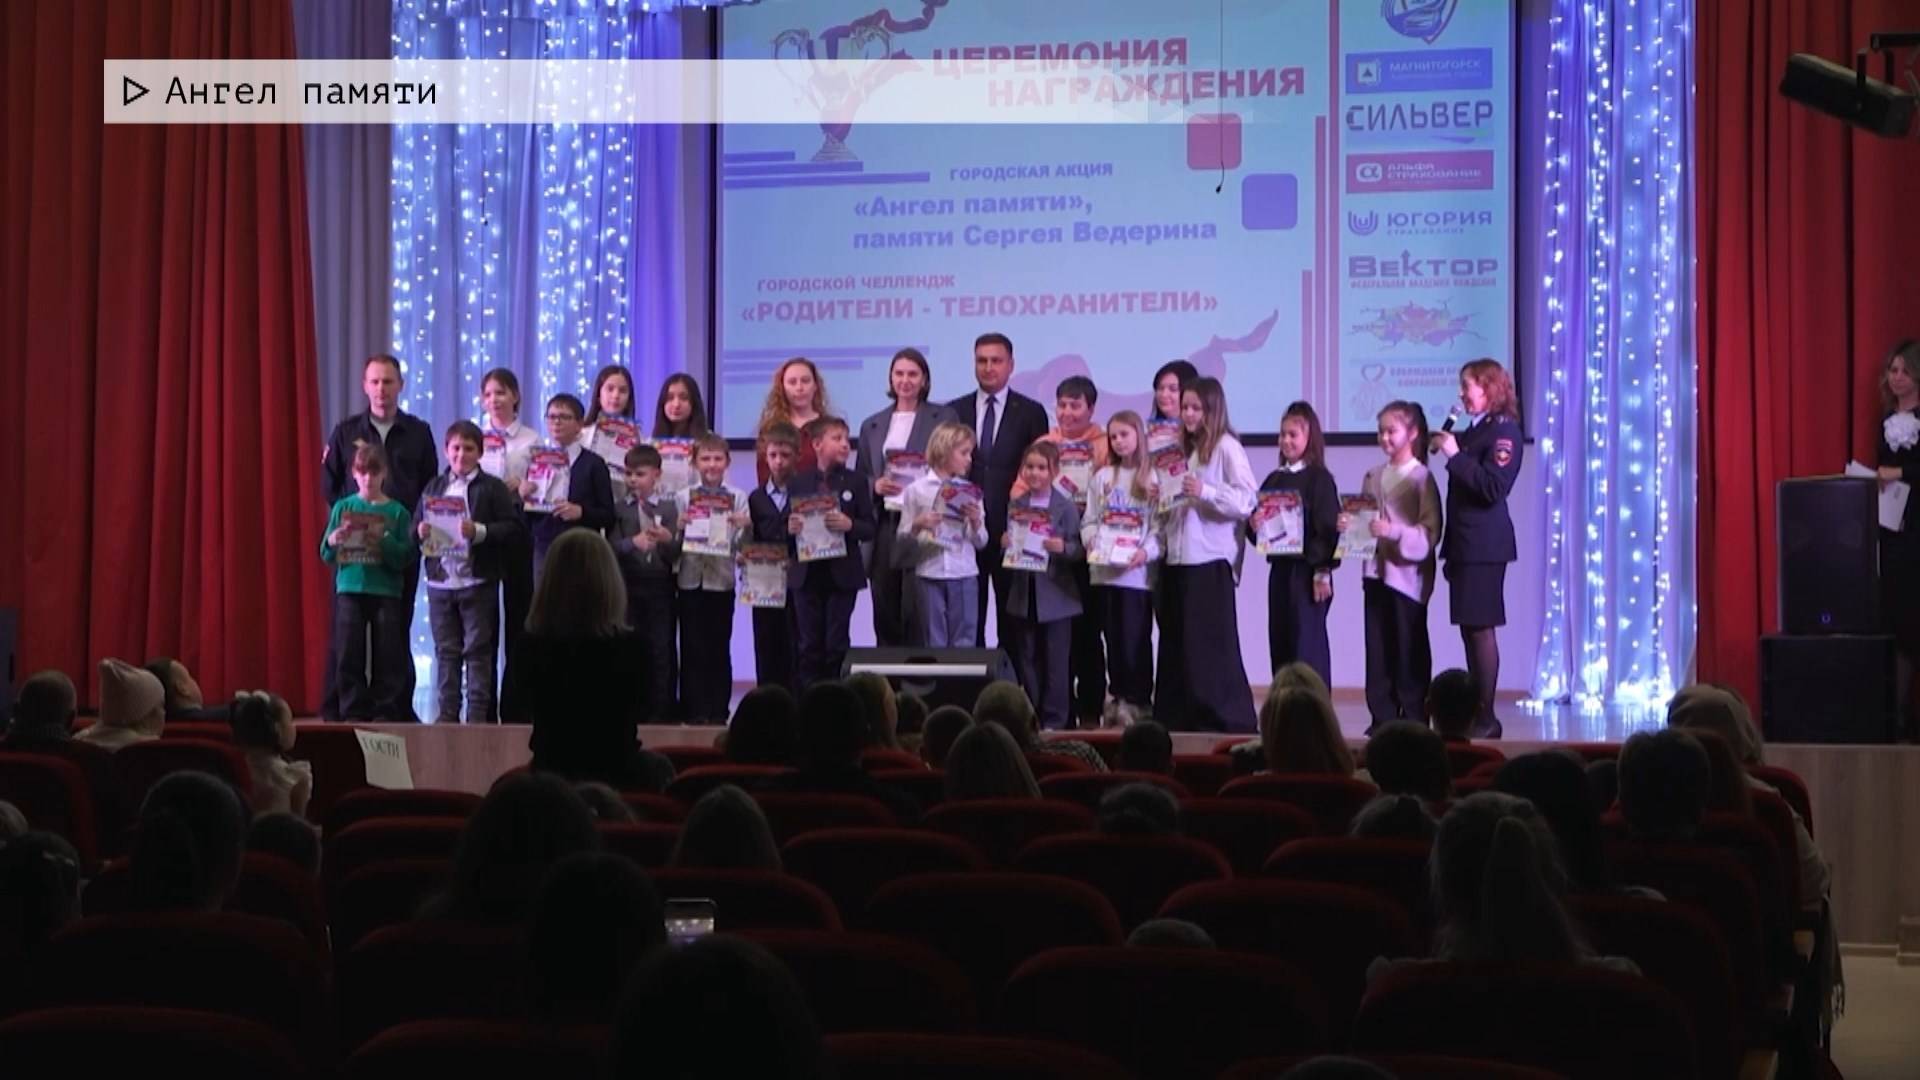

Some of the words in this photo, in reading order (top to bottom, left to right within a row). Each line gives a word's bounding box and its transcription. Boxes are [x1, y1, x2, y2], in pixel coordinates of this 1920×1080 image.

[933, 37, 1187, 79] ЦЕРЕМОНИЯ
[988, 67, 1304, 106] НАГРАЖДЕНИЯ
[1346, 100, 1493, 131] СИЛЬВЕР
[949, 164, 1050, 181] ГОРОДСКАЯ
[1055, 163, 1113, 179] АКЦИЯ
[854, 196, 954, 217] «Ангел
[963, 194, 1093, 214] памяти»,
[1387, 211, 1492, 227] ЮГОРИЯ
[853, 229, 953, 249] памяти
[963, 225, 1063, 249] Сергея
[1073, 220, 1217, 245] Ведерина
[757, 276, 855, 292] ГОРОДСКОЙ
[861, 273, 955, 290] ЧЕЛЛЕНДЖ
[741, 298, 913, 323] «РОДИТЕЛИ
[940, 290, 1218, 318] ТЕЛОХРАНИТЕЛИ»
